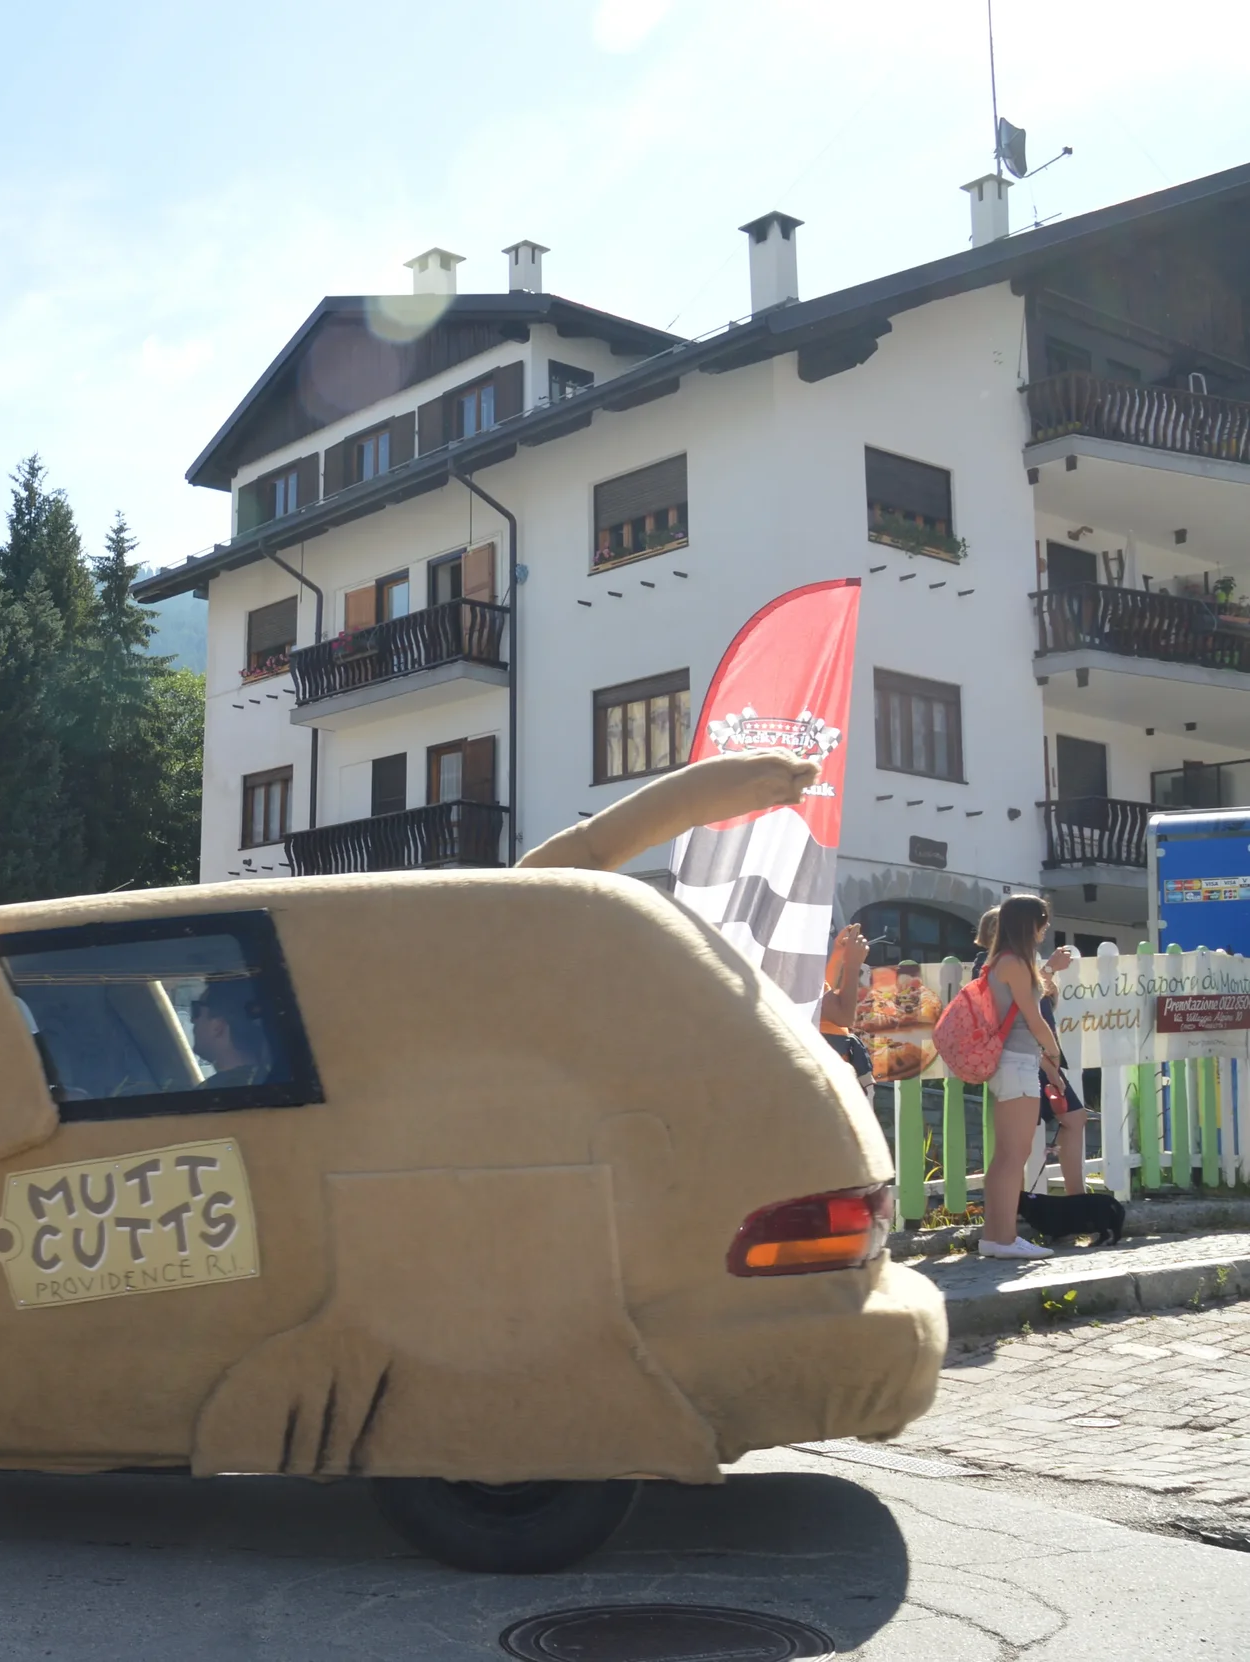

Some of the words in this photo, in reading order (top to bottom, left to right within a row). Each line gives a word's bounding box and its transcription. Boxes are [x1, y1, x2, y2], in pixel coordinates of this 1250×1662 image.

[730, 731, 780, 745] Wacky
[781, 733, 816, 749] Rally
[1062, 983, 1110, 1000] con
[1115, 973, 1133, 996] il
[1202, 967, 1218, 991] di
[1060, 1017, 1079, 1033] a
[1082, 1008, 1140, 1031] tutti!
[1164, 996, 1218, 1016] Prenotazione
[27, 1155, 220, 1223] MUTT
[31, 1191, 238, 1273] CUTTS
[35, 1258, 194, 1300] PROVIDENCE
